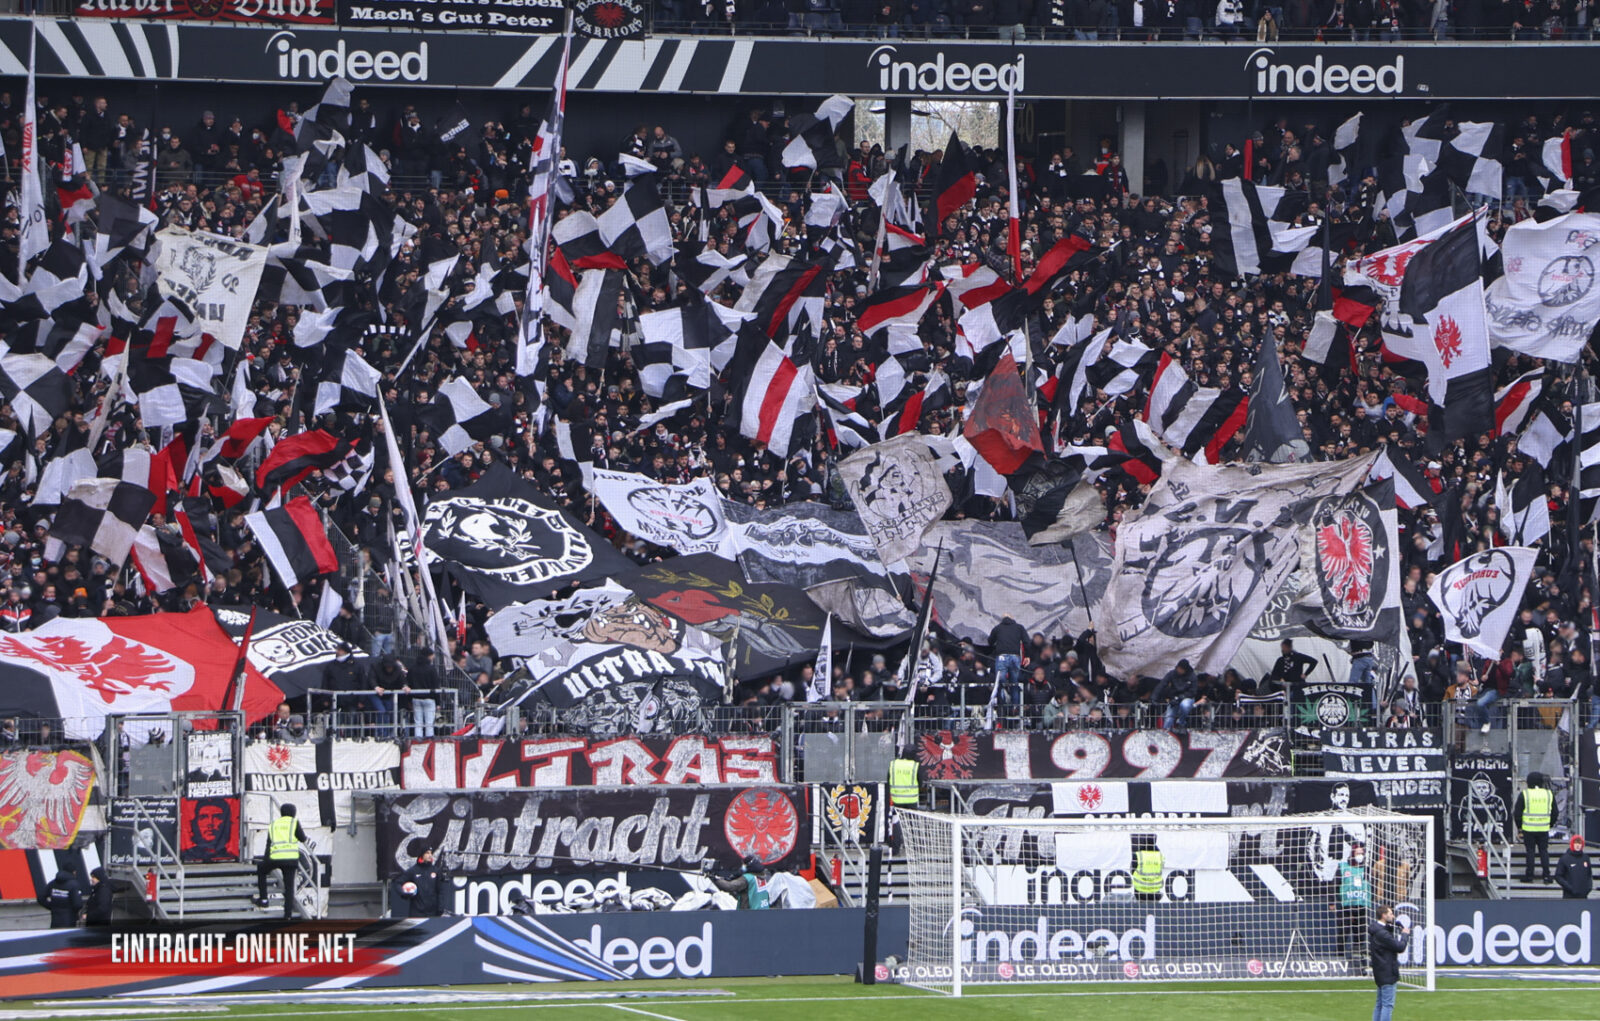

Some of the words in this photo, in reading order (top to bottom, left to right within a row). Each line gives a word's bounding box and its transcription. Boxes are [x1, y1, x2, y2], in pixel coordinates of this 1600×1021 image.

[438, 10, 483, 24] Gut
[488, 12, 553, 27] Peter
[575, 15, 643, 39] WARRIORS
[277, 39, 428, 81] indeed
[878, 51, 1024, 92] indeed
[1255, 54, 1404, 94] indeed
[563, 648, 676, 699] ULTRA
[1302, 684, 1364, 697] HIGH
[1331, 731, 1433, 748] ULTRAS
[402, 736, 779, 789] ULTRAS
[993, 730, 1250, 780] 1997
[1340, 755, 1428, 772] NEVER
[251, 774, 308, 791] NUOVA
[317, 770, 395, 791] GUARDIA
[392, 793, 713, 871] Eintracht
[1026, 866, 1196, 904] inded
[957, 913, 1156, 961] indeed
[915, 965, 953, 978] OLED
[1016, 965, 1035, 977] LG
[1041, 964, 1077, 977] OLED
[1079, 964, 1099, 976] TV
[1141, 964, 1160, 976] LG
[1165, 963, 1202, 975] OLED
[1204, 963, 1222, 974] TV
[1266, 962, 1284, 974] LG
[1330, 961, 1349, 973] TV
